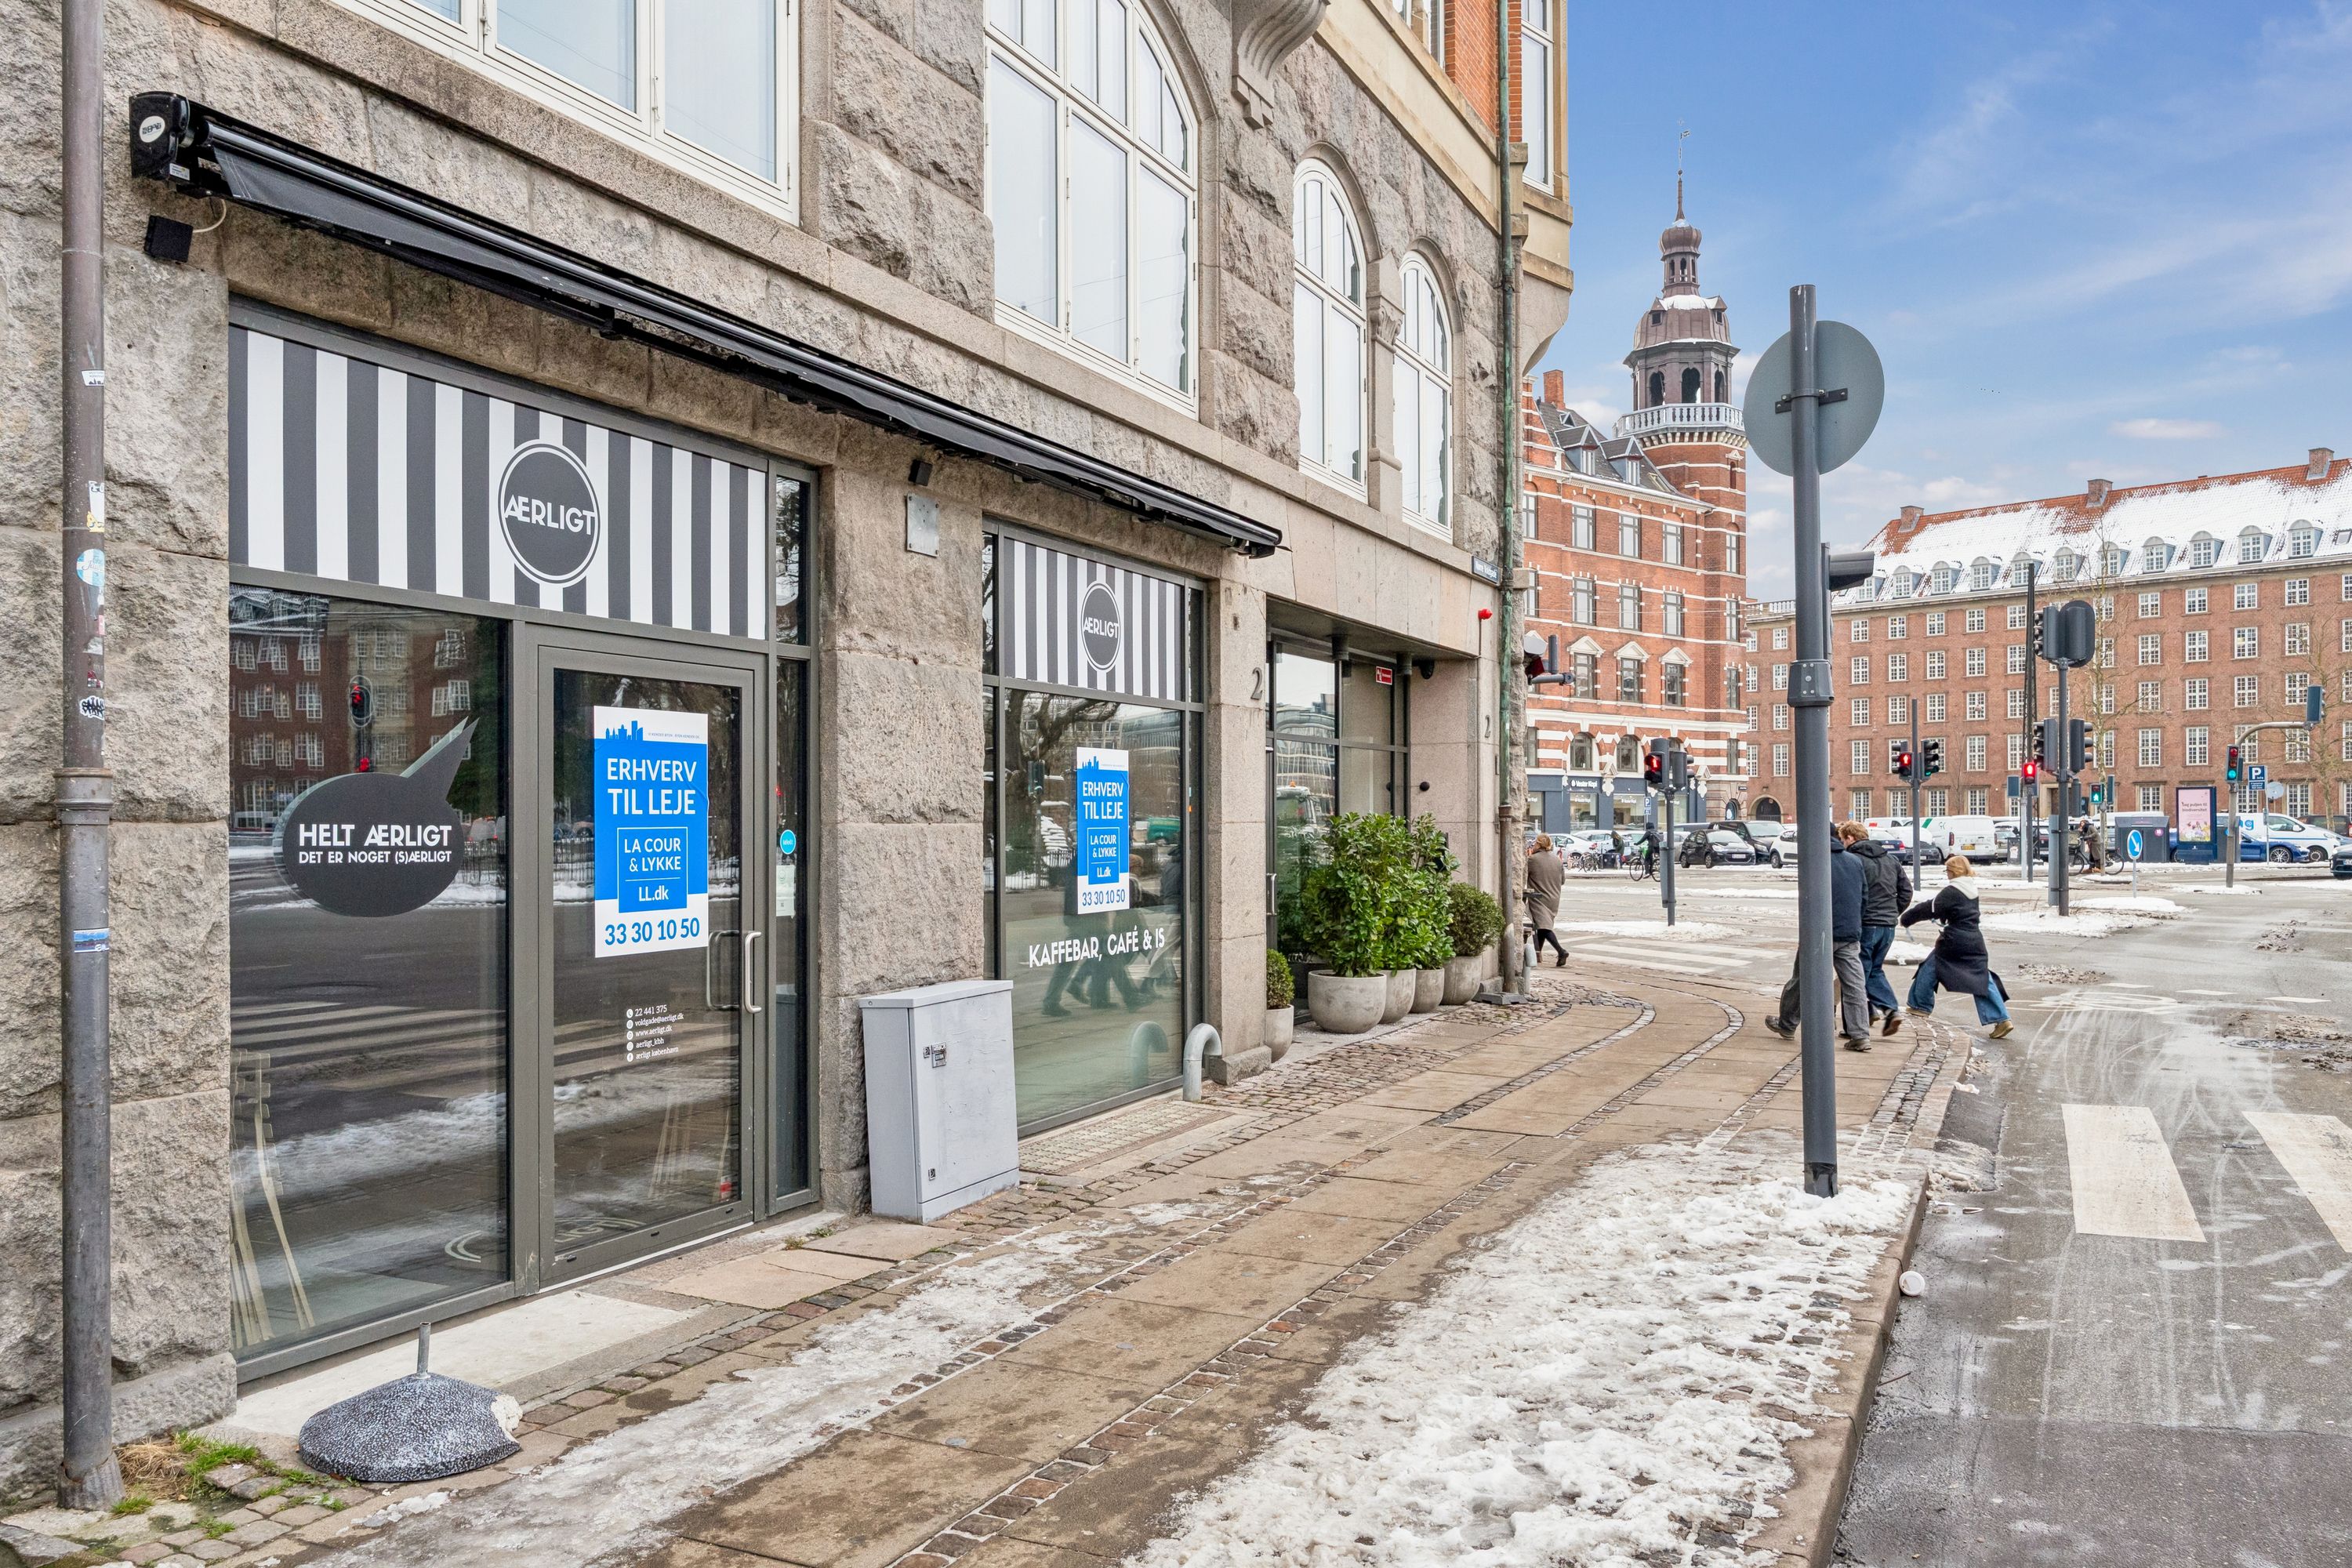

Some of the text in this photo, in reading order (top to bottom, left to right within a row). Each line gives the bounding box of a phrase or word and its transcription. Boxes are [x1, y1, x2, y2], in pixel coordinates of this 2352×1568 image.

[504, 494, 596, 535] ÆRLIGT
[1083, 616, 1120, 638] ÆRLIGT
[1250, 666, 1264, 700] 2
[608, 758, 697, 782] ERHVERV
[1083, 782, 1123, 797] ERHVERV
[608, 789, 695, 815] TIL LEJE
[1083, 802, 1123, 819] TIL LEJE
[299, 824, 452, 847] HELT ÆRLIGT
[1091, 835, 1116, 845] LA COUR
[624, 838, 681, 853] LA COUR
[1093, 848, 1116, 858] & LYKKE
[299, 851, 323, 863] DET
[328, 851, 343, 863] ER
[349, 851, 390, 863] NOGET
[629, 856, 681, 872] & LYKKE
[1097, 866, 1111, 877] LL.dk
[639, 885, 669, 901] LL.dk
[1083, 889, 1125, 906] 33 30 10 50
[605, 917, 700, 945] 33 30 10 50
[1029, 925, 1165, 968] KAFFEBAR, CAFÉ & IS
[635, 1005, 667, 1017] 22 441 375
[635, 1025, 672, 1037] www.aerligt.dk
